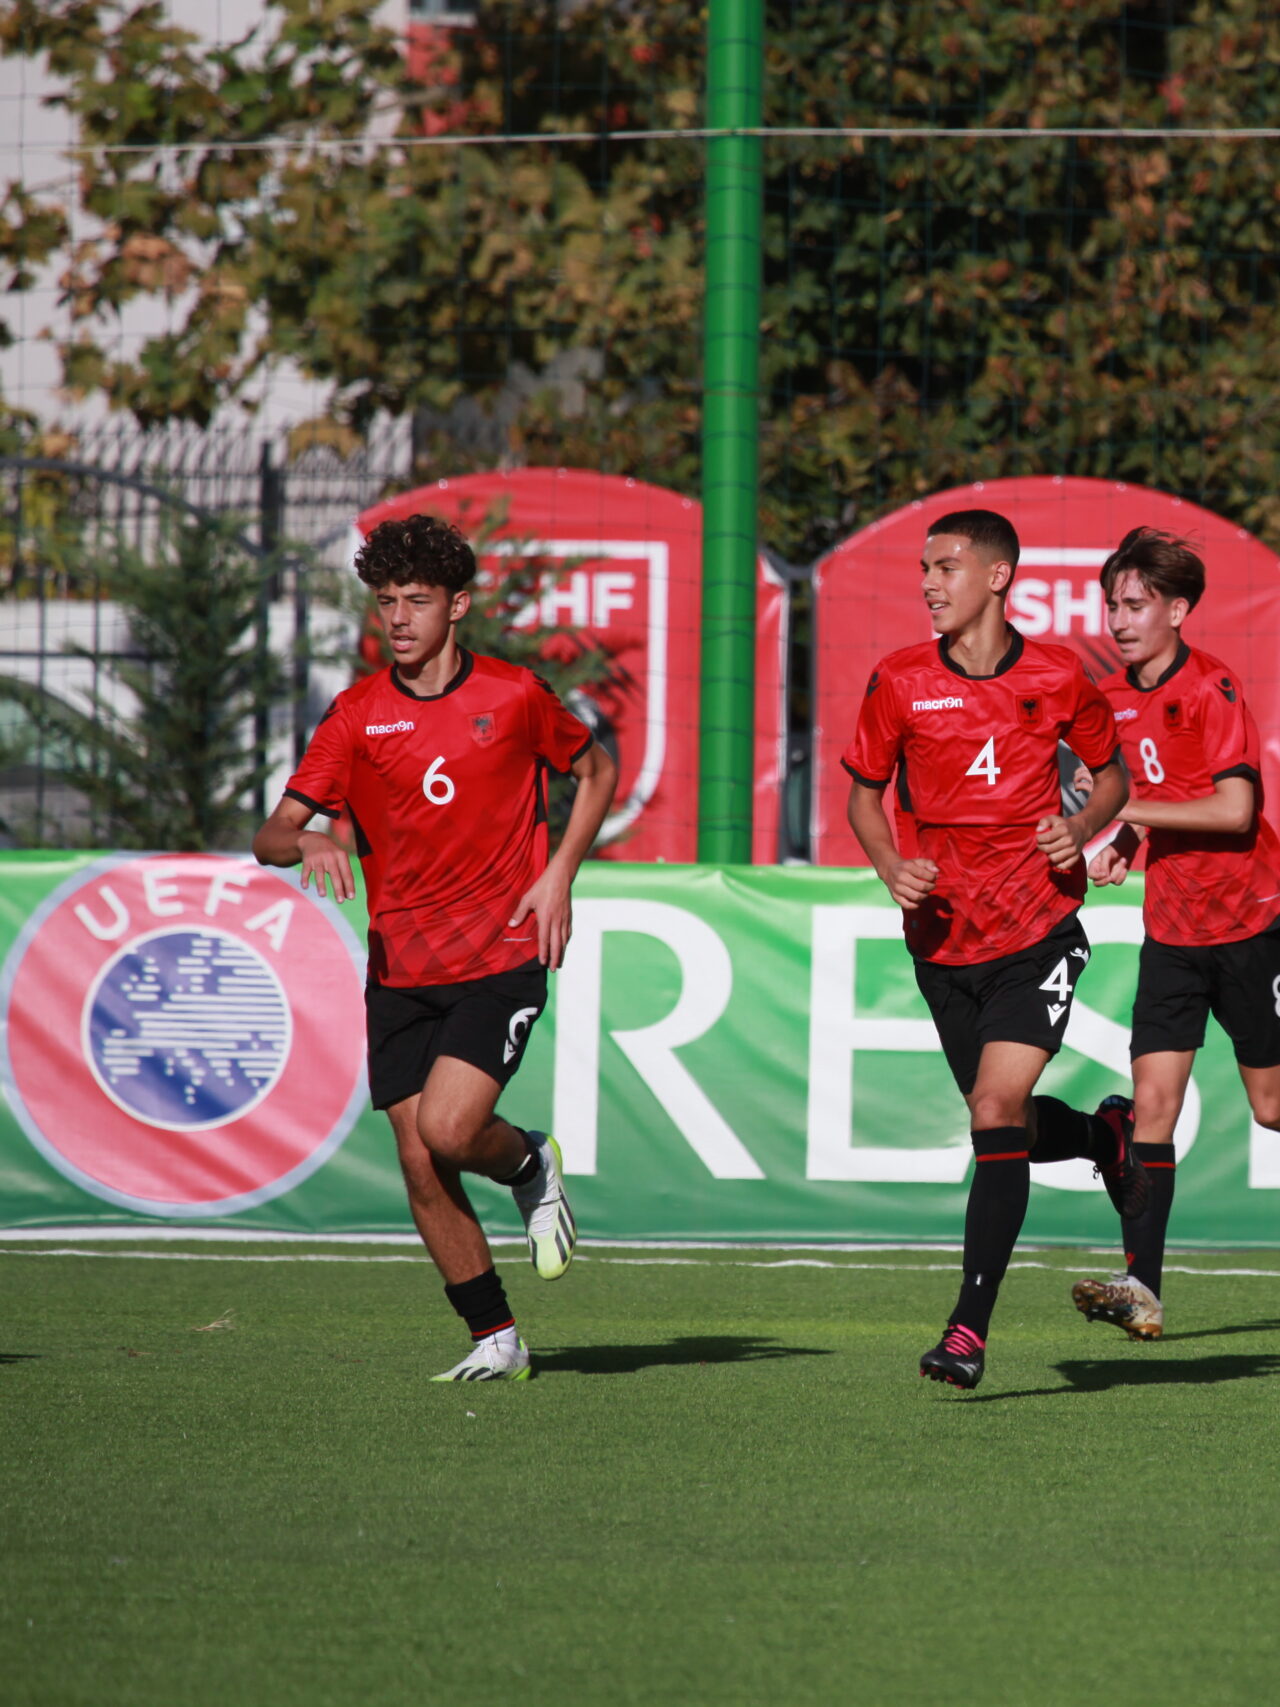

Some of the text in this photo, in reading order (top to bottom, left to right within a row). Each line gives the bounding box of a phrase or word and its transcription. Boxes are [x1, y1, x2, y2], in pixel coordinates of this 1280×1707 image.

[1004, 577, 1114, 637] SH
[365, 720, 416, 736] macron
[913, 697, 964, 712] macron
[422, 755, 456, 806] 6
[965, 735, 1002, 786] 4
[1140, 737, 1166, 785] 8
[73, 867, 296, 952] UEFA
[1038, 956, 1073, 1002] 4
